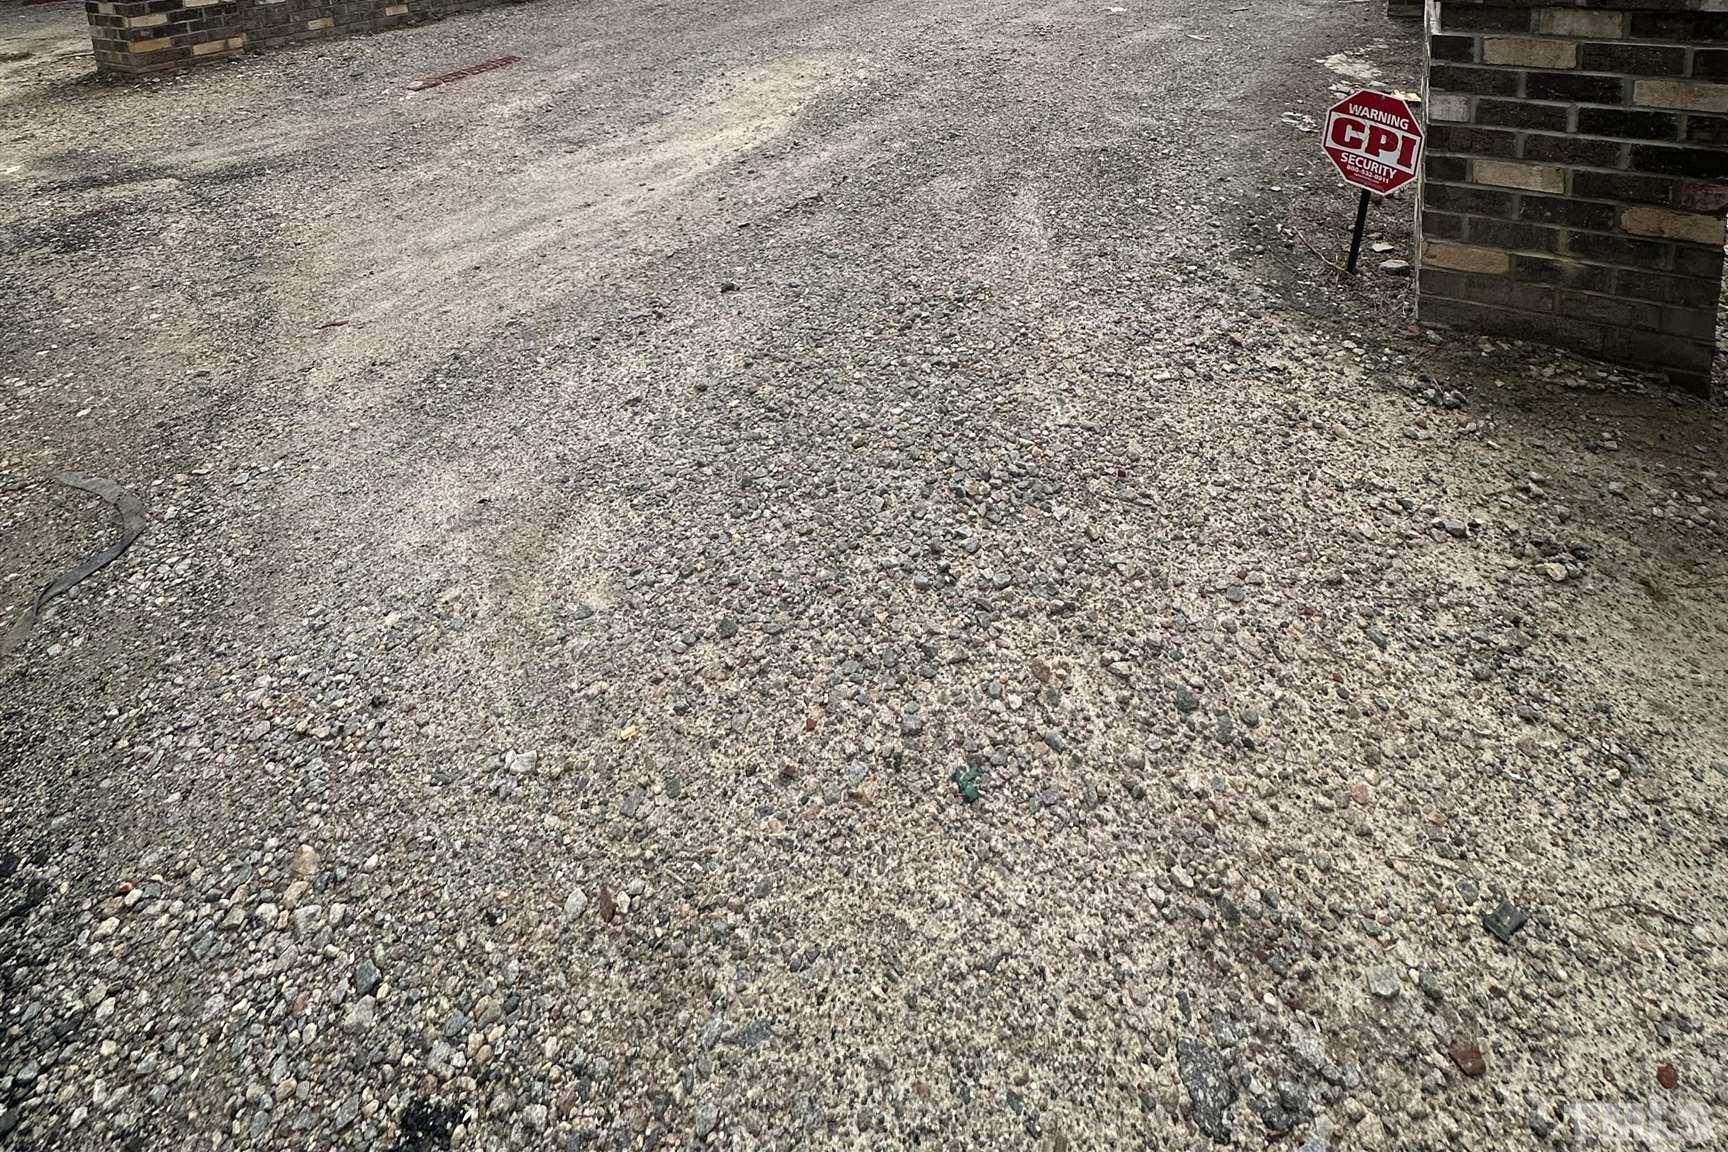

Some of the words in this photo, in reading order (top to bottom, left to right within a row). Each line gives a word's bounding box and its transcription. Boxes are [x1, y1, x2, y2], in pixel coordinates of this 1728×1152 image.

[1348, 103, 1409, 130] WARNING
[1332, 117, 1417, 169] CPI
[1340, 152, 1397, 179] SECURITY
